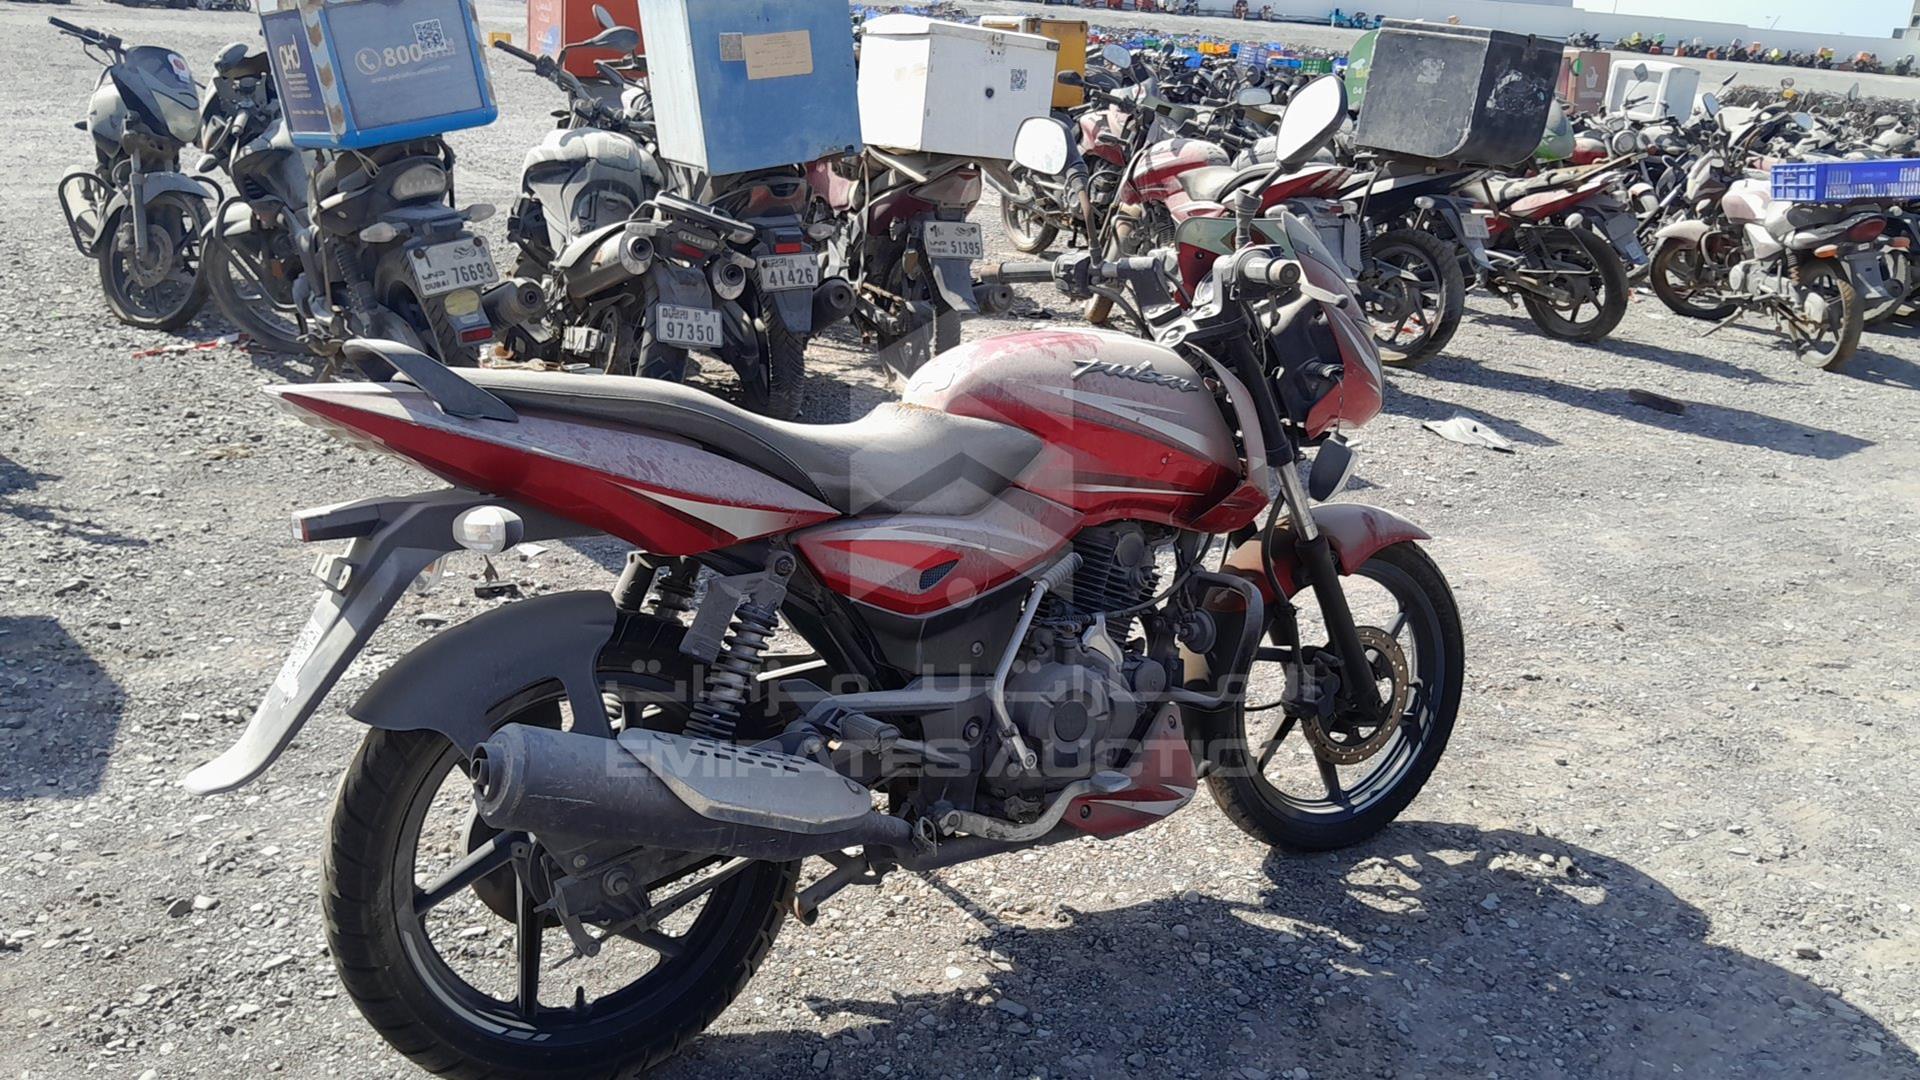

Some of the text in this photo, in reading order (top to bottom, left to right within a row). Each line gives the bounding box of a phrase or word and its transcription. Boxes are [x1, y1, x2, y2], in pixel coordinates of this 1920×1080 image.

[950, 240, 981, 255] 51395
[451, 261, 494, 285] 76693
[769, 268, 814, 287] 41426
[667, 321, 714, 342] 97350
